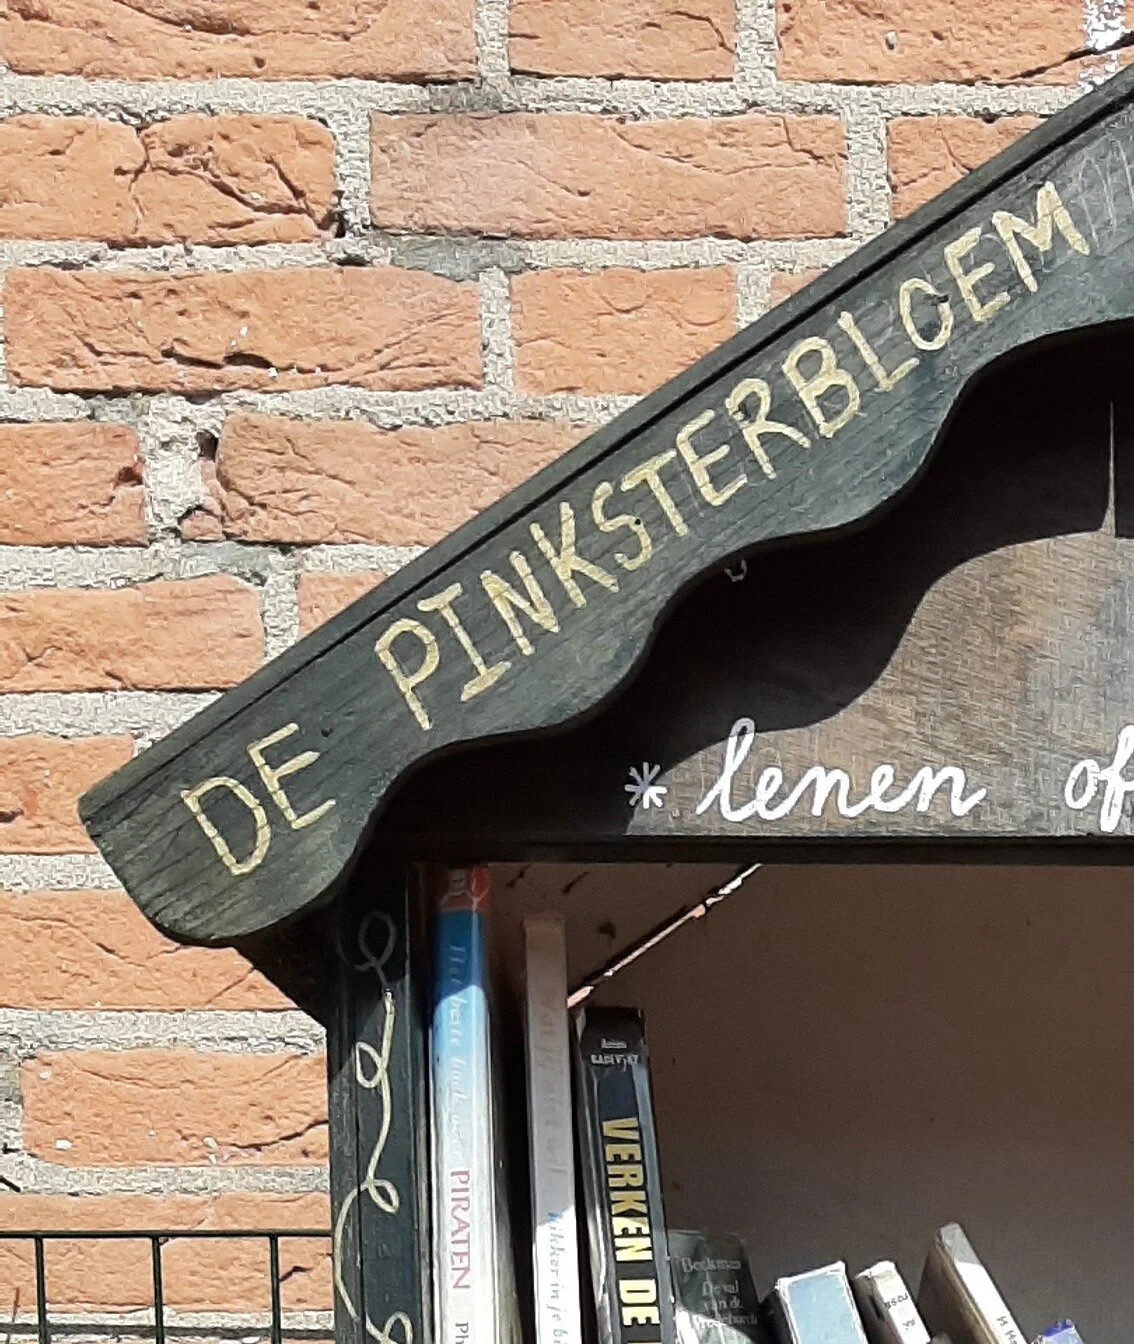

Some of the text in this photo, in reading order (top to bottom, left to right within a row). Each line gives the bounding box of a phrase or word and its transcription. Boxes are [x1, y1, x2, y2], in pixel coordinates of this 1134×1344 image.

[181, 181, 1092, 876] DE PINKSTERBLOEM
[697, 719, 986, 823] lenen
[447, 1169, 473, 1290] PIRATEN
[597, 1115, 657, 1265] VERKEN
[548, 1281, 566, 1298] in
[616, 1274, 661, 1329] DE
